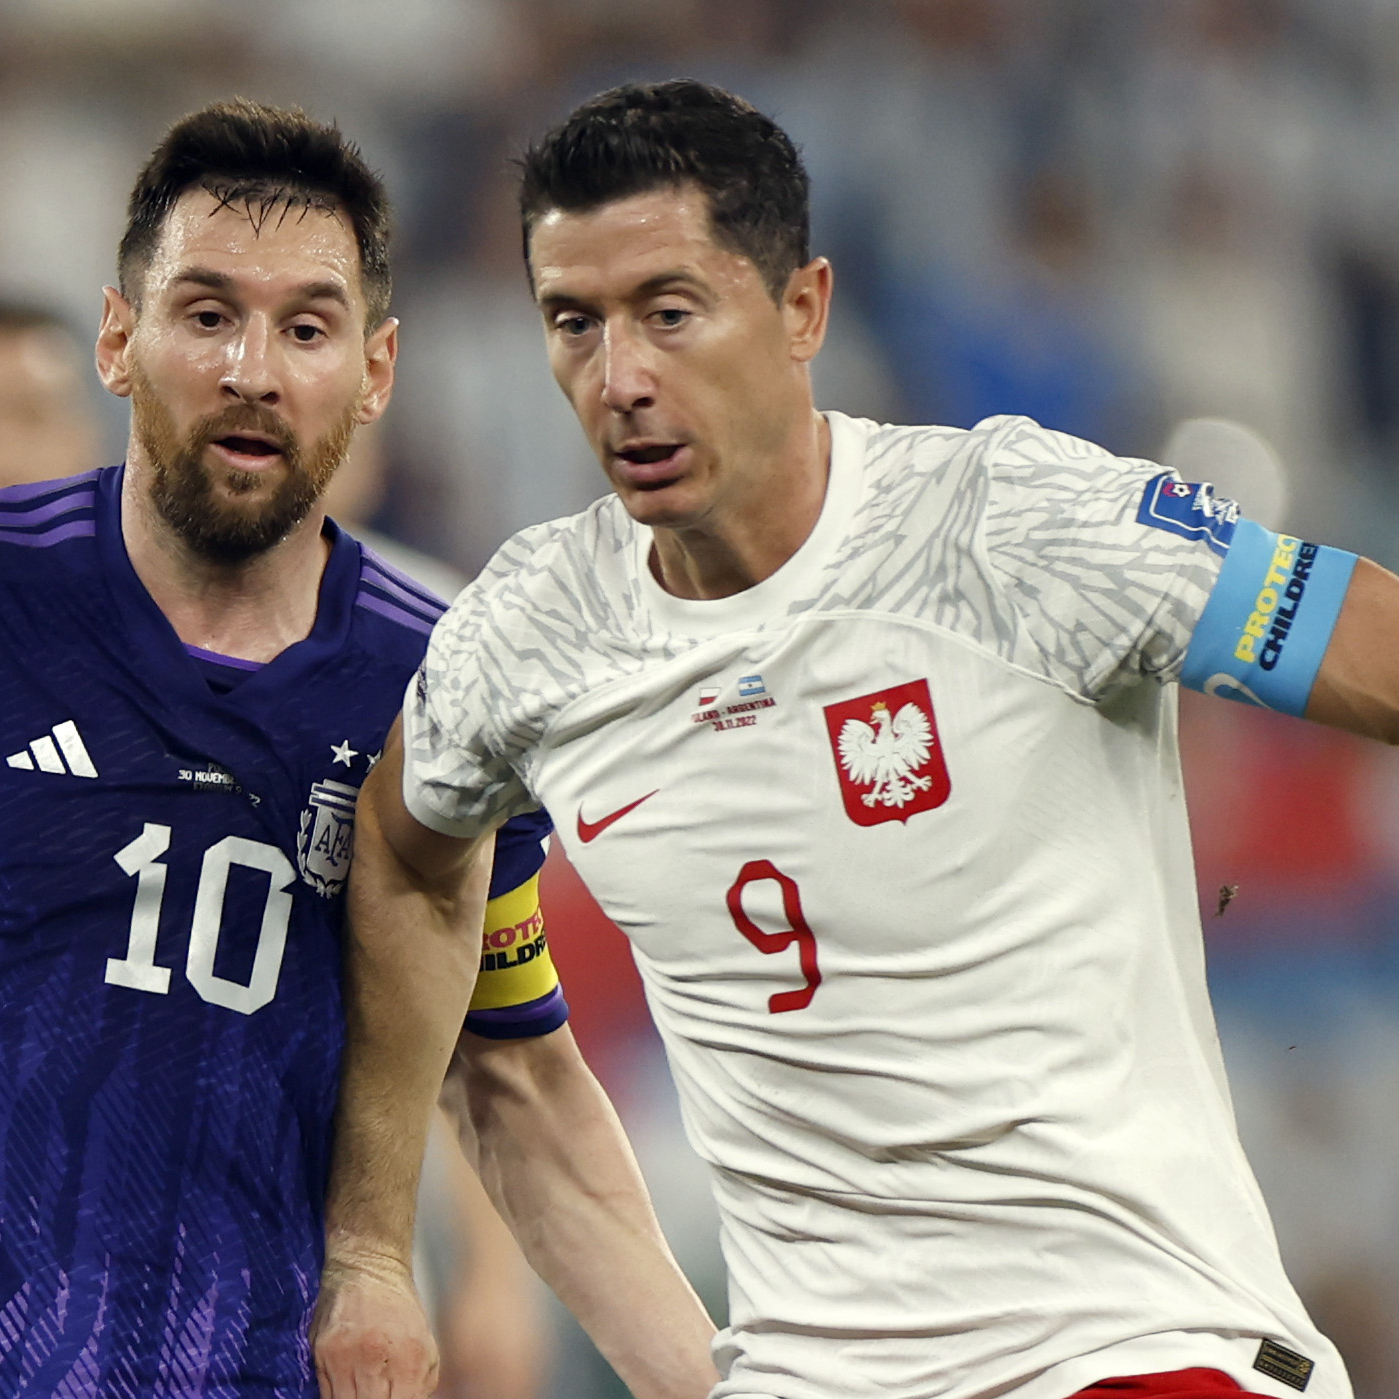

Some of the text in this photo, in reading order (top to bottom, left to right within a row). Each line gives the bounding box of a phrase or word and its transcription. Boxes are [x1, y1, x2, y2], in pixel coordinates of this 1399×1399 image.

[1259, 542, 1320, 672] CHILDRE
[177, 769, 193, 781] 30
[104, 822, 298, 1016] 10
[726, 859, 823, 1014] 9
